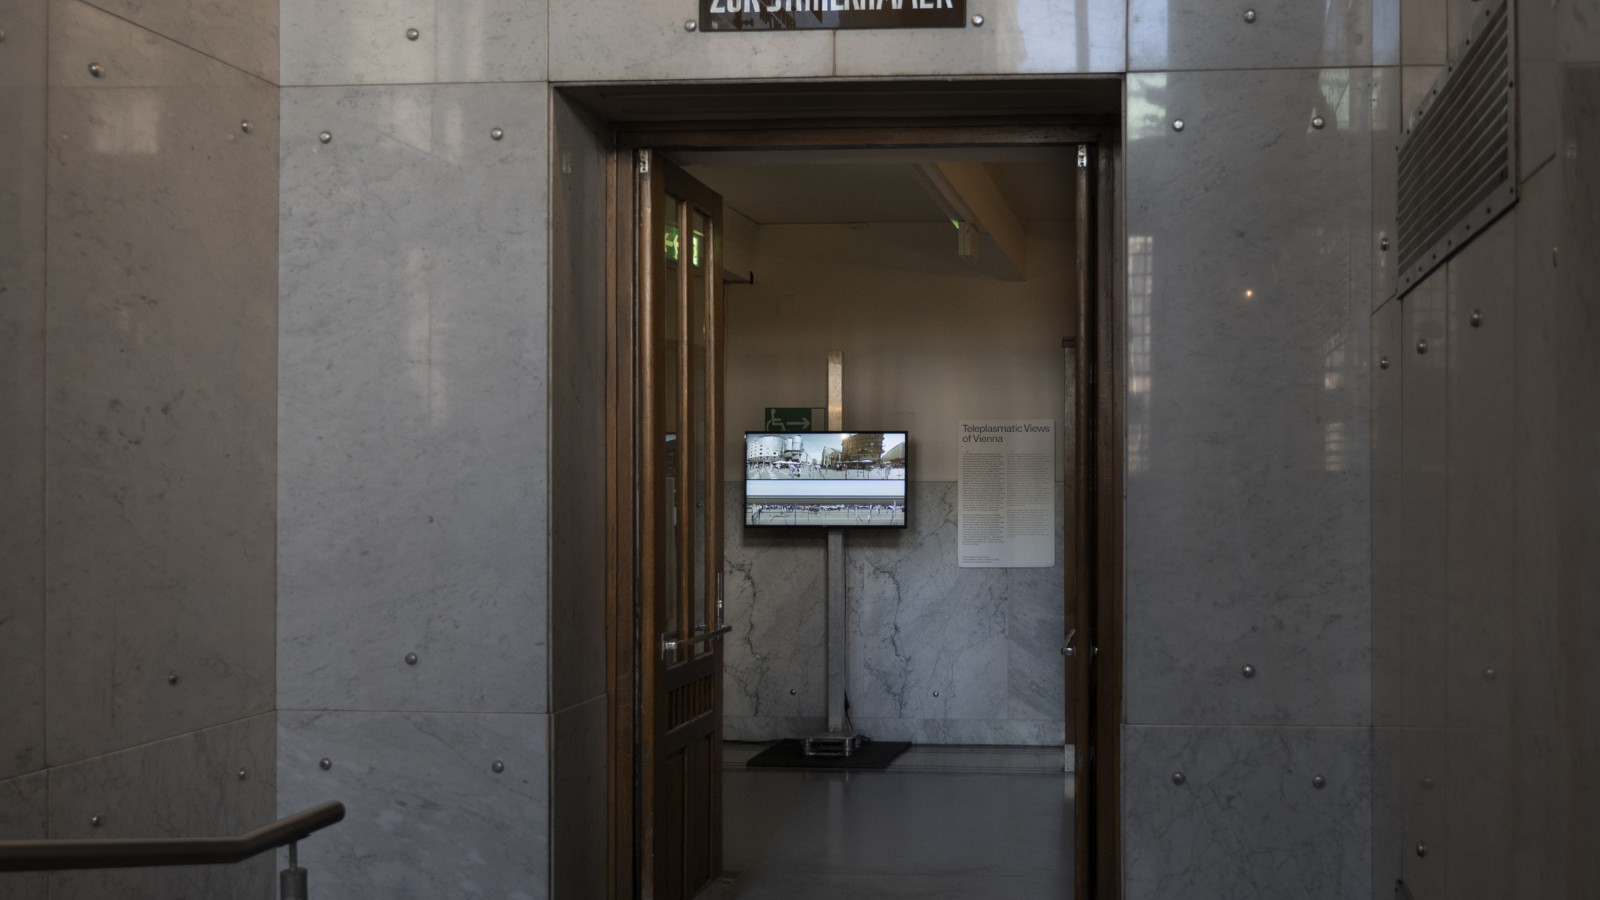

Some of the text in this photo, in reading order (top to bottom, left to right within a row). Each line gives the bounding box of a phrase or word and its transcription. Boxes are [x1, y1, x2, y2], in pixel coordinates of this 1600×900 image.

[962, 424, 1050, 434] Teleplasmatic Views
[962, 434, 1003, 443] of Vienna
